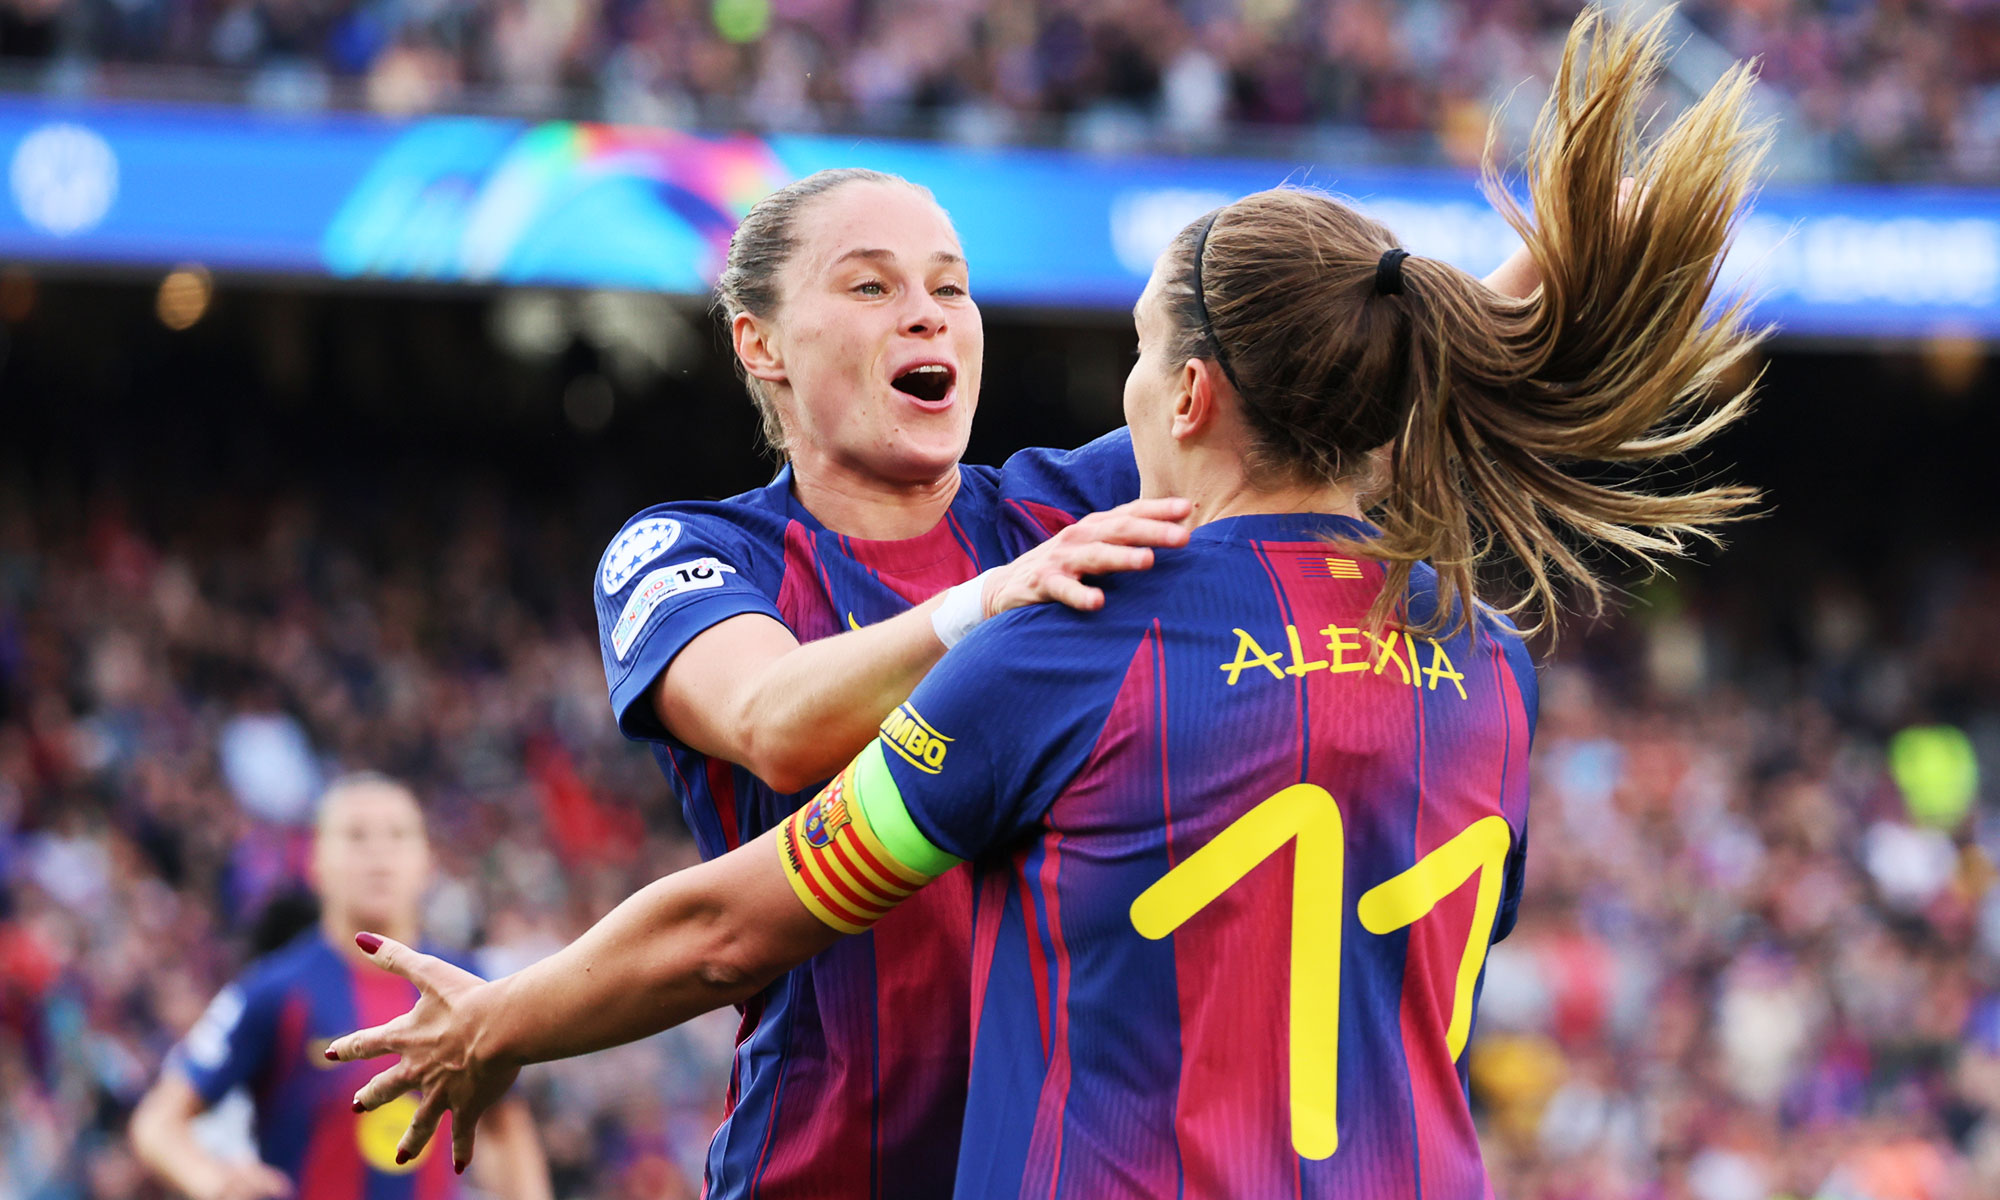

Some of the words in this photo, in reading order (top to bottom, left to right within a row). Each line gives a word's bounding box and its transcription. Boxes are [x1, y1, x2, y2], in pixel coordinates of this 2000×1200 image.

[676, 566, 714, 582] 10
[1219, 623, 1468, 700] ALEXIA
[880, 706, 947, 767] IMBO
[1129, 783, 1511, 1161] 11
